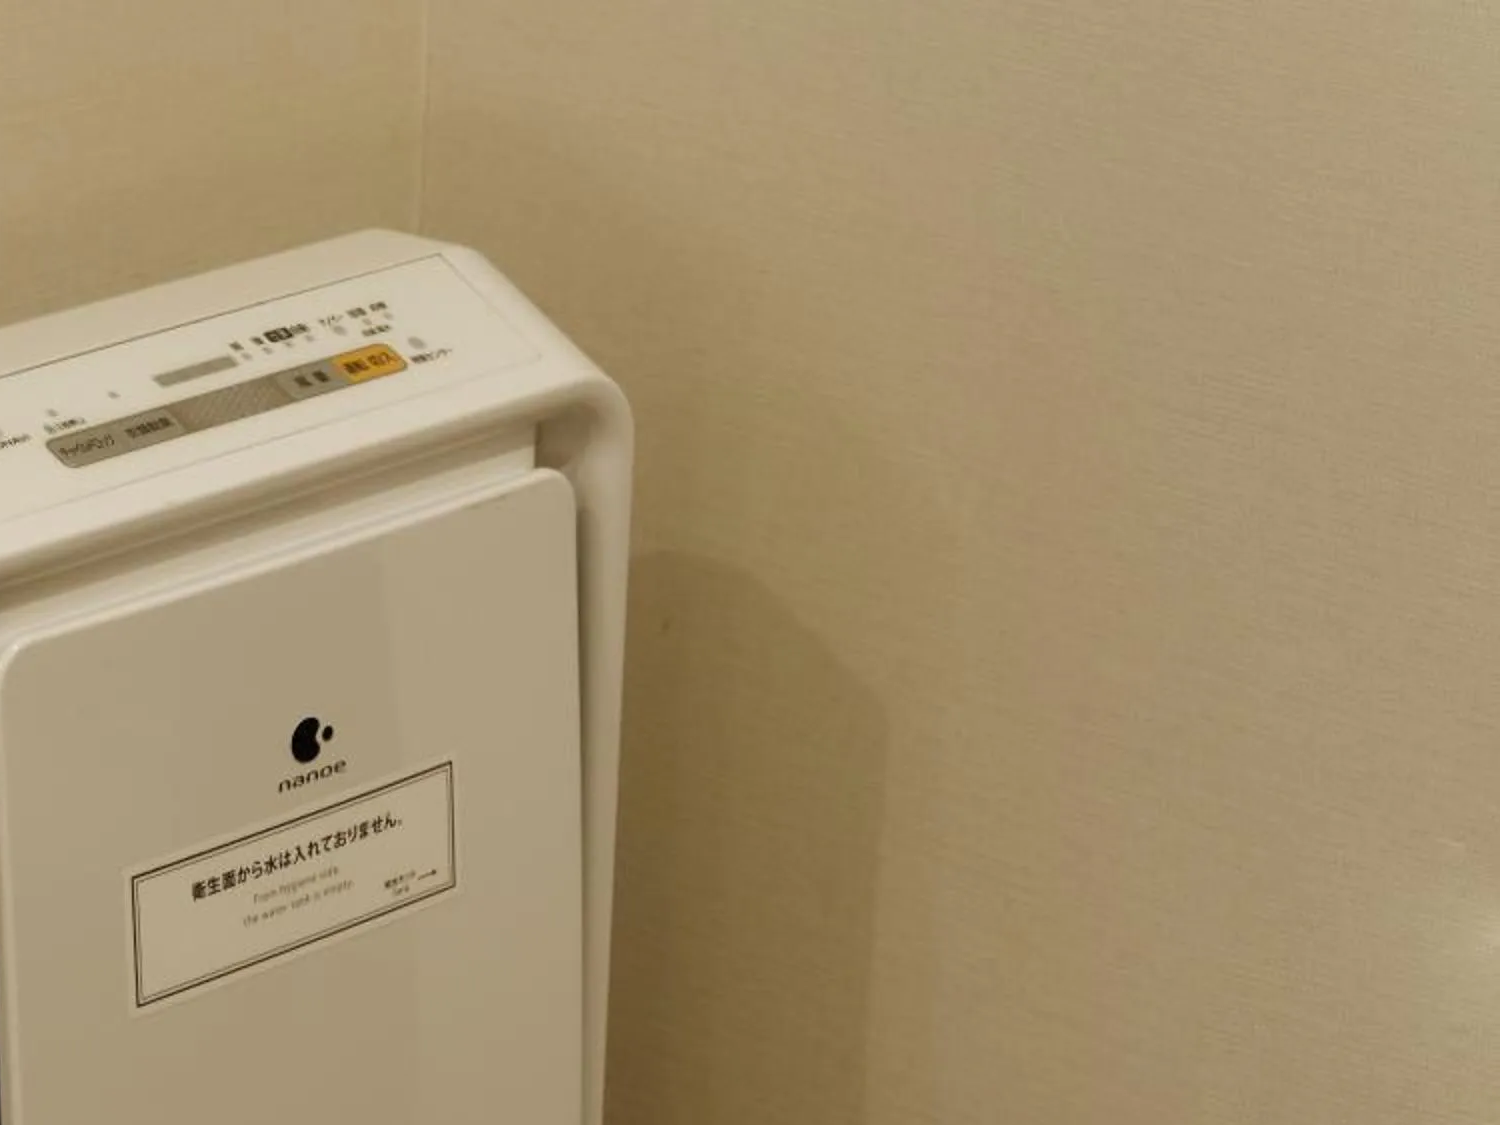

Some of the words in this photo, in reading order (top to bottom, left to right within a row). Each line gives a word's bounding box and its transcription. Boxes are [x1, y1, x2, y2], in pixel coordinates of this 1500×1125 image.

[279, 760, 347, 792] nanoe
[192, 812, 403, 902] 衛生面から水は入れておりません。
